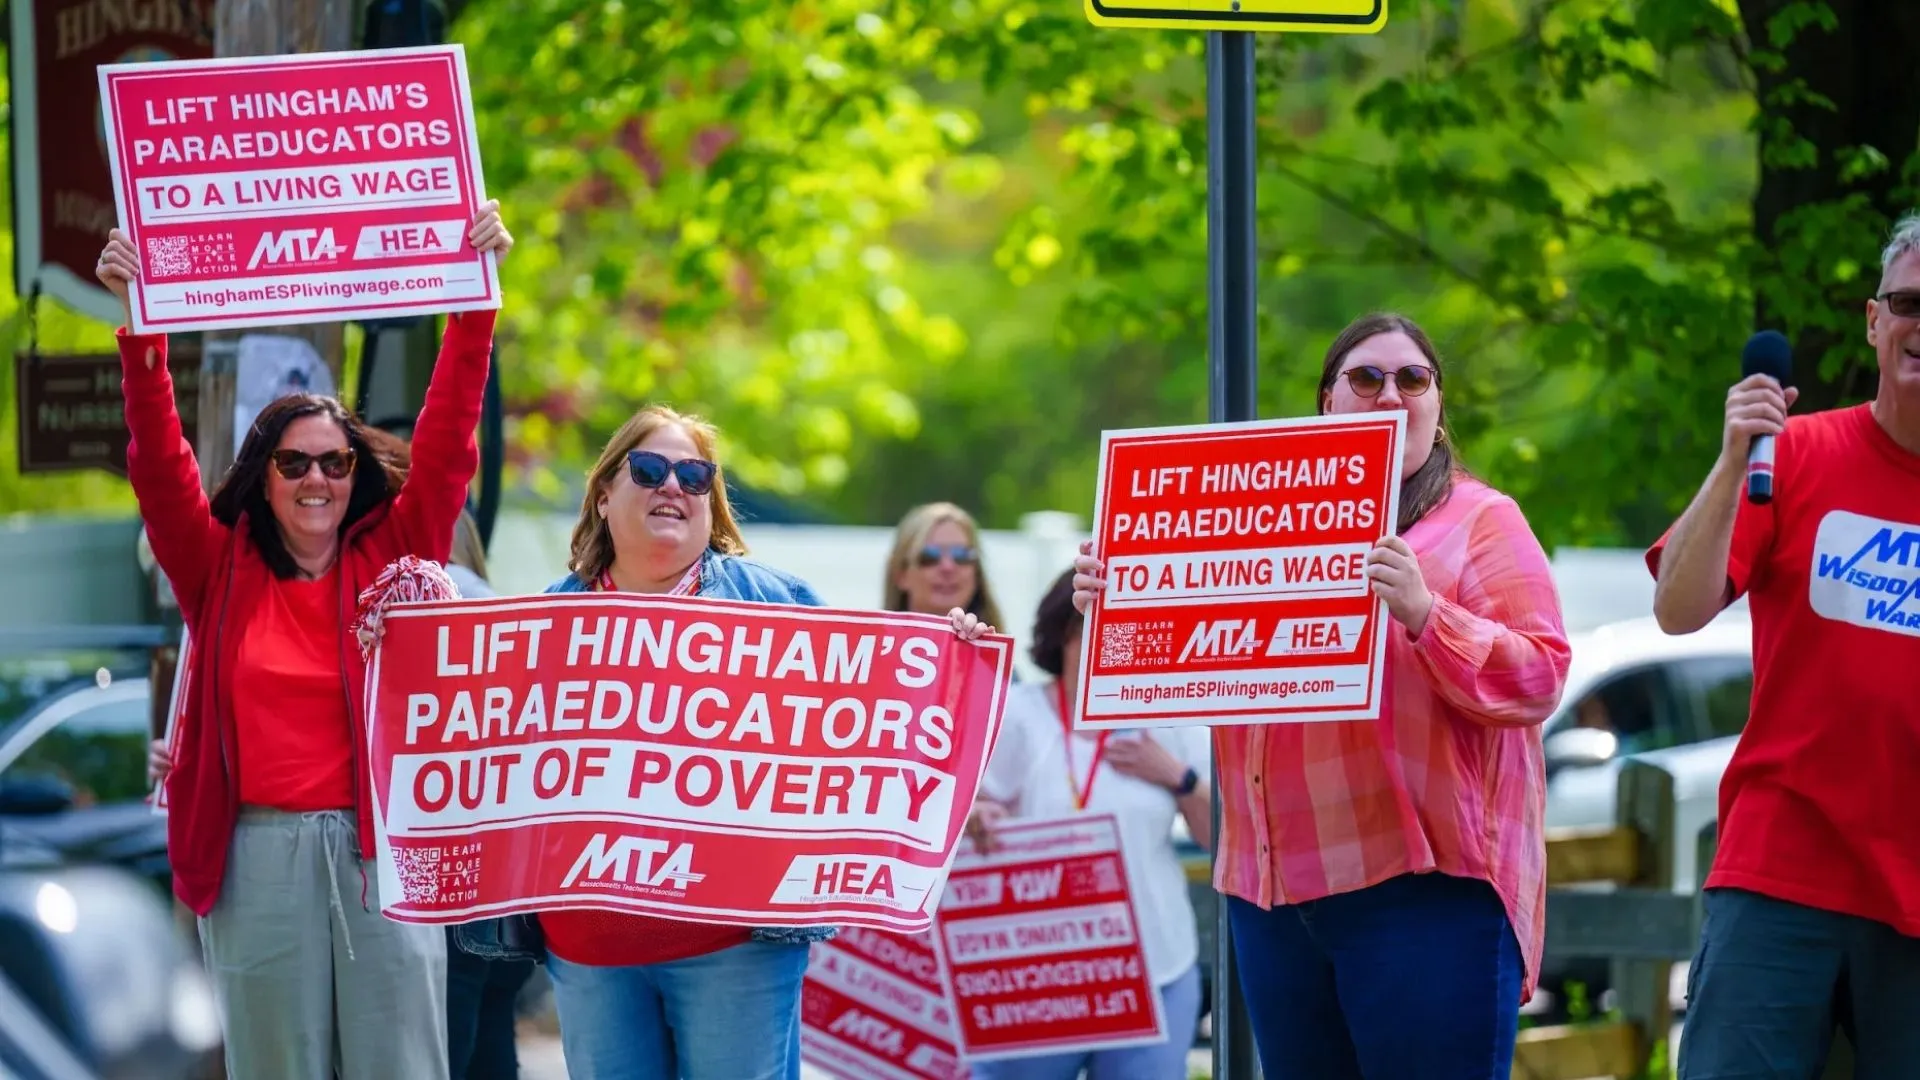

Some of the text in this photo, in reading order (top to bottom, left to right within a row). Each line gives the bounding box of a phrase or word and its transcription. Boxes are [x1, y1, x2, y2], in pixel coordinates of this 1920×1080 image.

[145, 82, 429, 126] LIFT HINGHAM'S
[134, 119, 452, 166] PARAEDUCATORS
[146, 167, 452, 210] TO A LIVING WAGE
[190, 232, 233, 243] LEARN
[192, 243, 235, 253] MORE
[247, 227, 348, 271] MTA
[380, 227, 442, 251] HEA
[193, 254, 236, 264] TAKE
[195, 264, 238, 274] ACTION
[185, 276, 443, 307] hinghamESPlivingwage.com
[1131, 455, 1366, 498] LIFT HINGHAM'S
[1113, 498, 1376, 542] PARAEDUCATORS
[1114, 553, 1365, 593] TO A LIVING WAGE
[1137, 633, 1173, 642] MORE
[1138, 621, 1174, 630] LEARN
[1292, 622, 1342, 648] HEA
[436, 616, 939, 688] LIFT HINGHAM'S
[1136, 645, 1172, 654] TAKE
[1176, 618, 1264, 664] MTA
[1134, 657, 1171, 666] ACTION
[1120, 679, 1335, 704] hinghamESPlivingwage.com
[405, 680, 955, 760] PARAEDUCATORS
[412, 748, 942, 823] OUT OF POVERTY
[443, 842, 482, 857] LEARN
[560, 833, 706, 890] MTA
[442, 858, 480, 873] MORE
[442, 873, 479, 887] TAKE
[813, 862, 895, 899] HEA
[440, 888, 478, 903] ACTION
